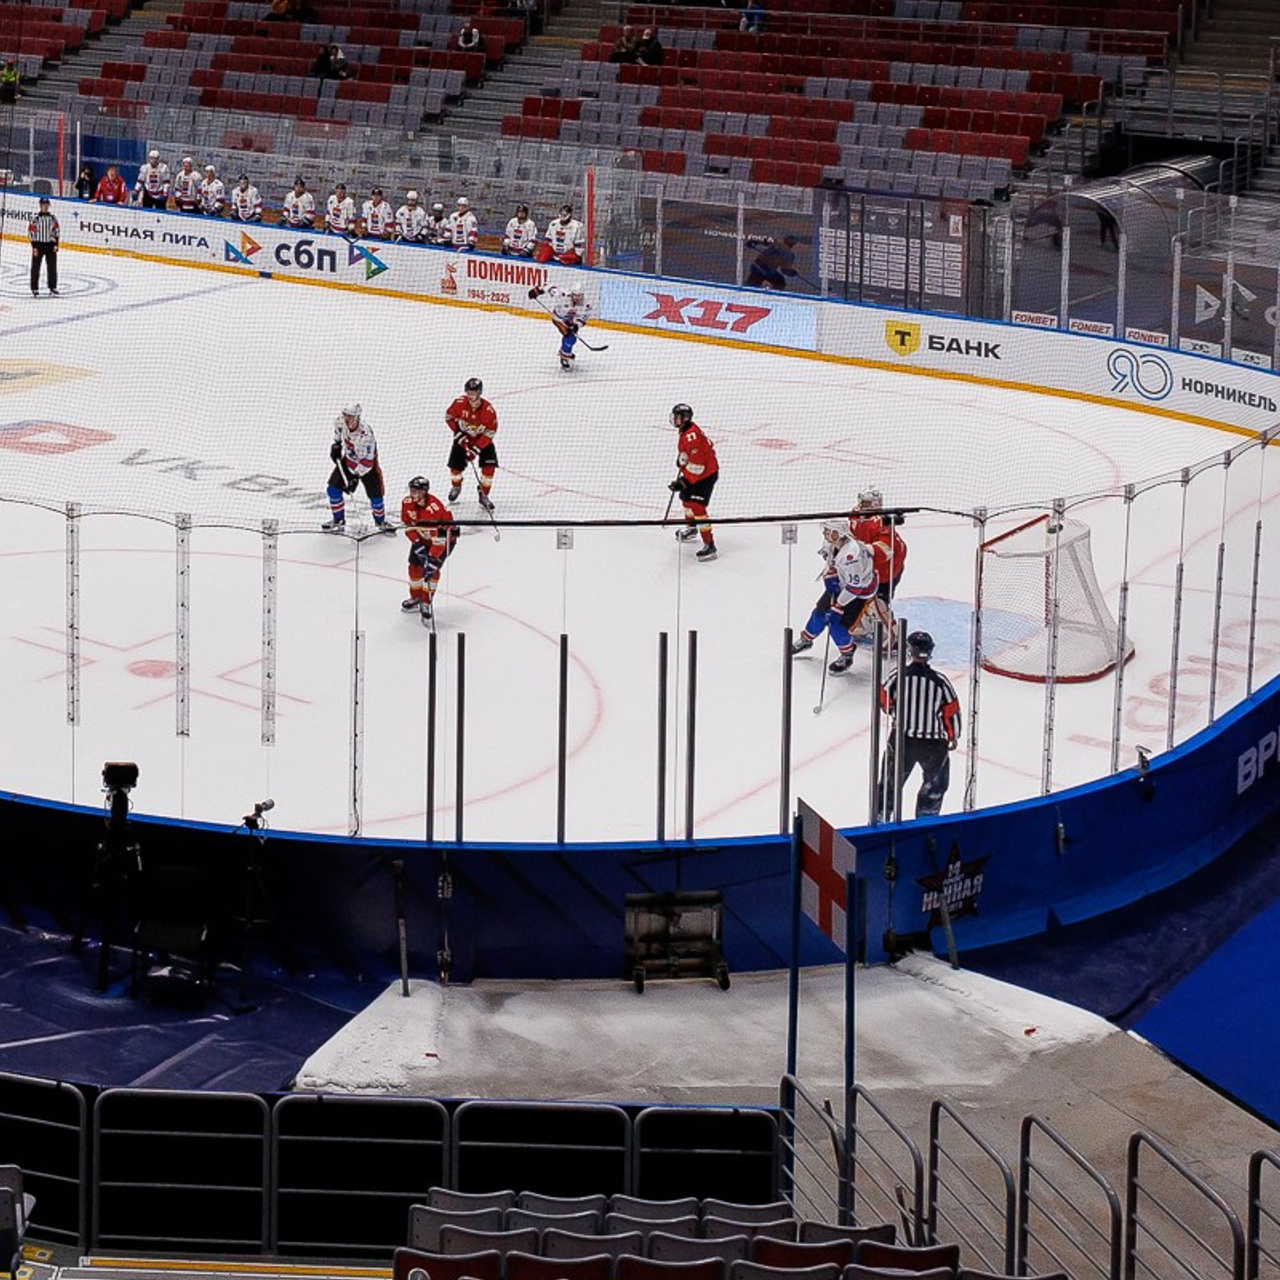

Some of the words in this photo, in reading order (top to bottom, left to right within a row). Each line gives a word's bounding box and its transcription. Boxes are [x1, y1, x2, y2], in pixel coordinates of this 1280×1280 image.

[79, 219, 155, 241] НОЧНАЯ
[161, 231, 210, 250] ЛИГА
[274, 238, 337, 274] сбп
[467, 258, 549, 288] ПОМНИМ!
[642, 290, 772, 334] X17
[1014, 313, 1056, 327] FONBET
[1070, 321, 1112, 335] FONBET
[1127, 329, 1167, 344] FONBET
[927, 334, 1002, 361] БАНК
[1181, 377, 1277, 413] НОРНИКЕЛЬ
